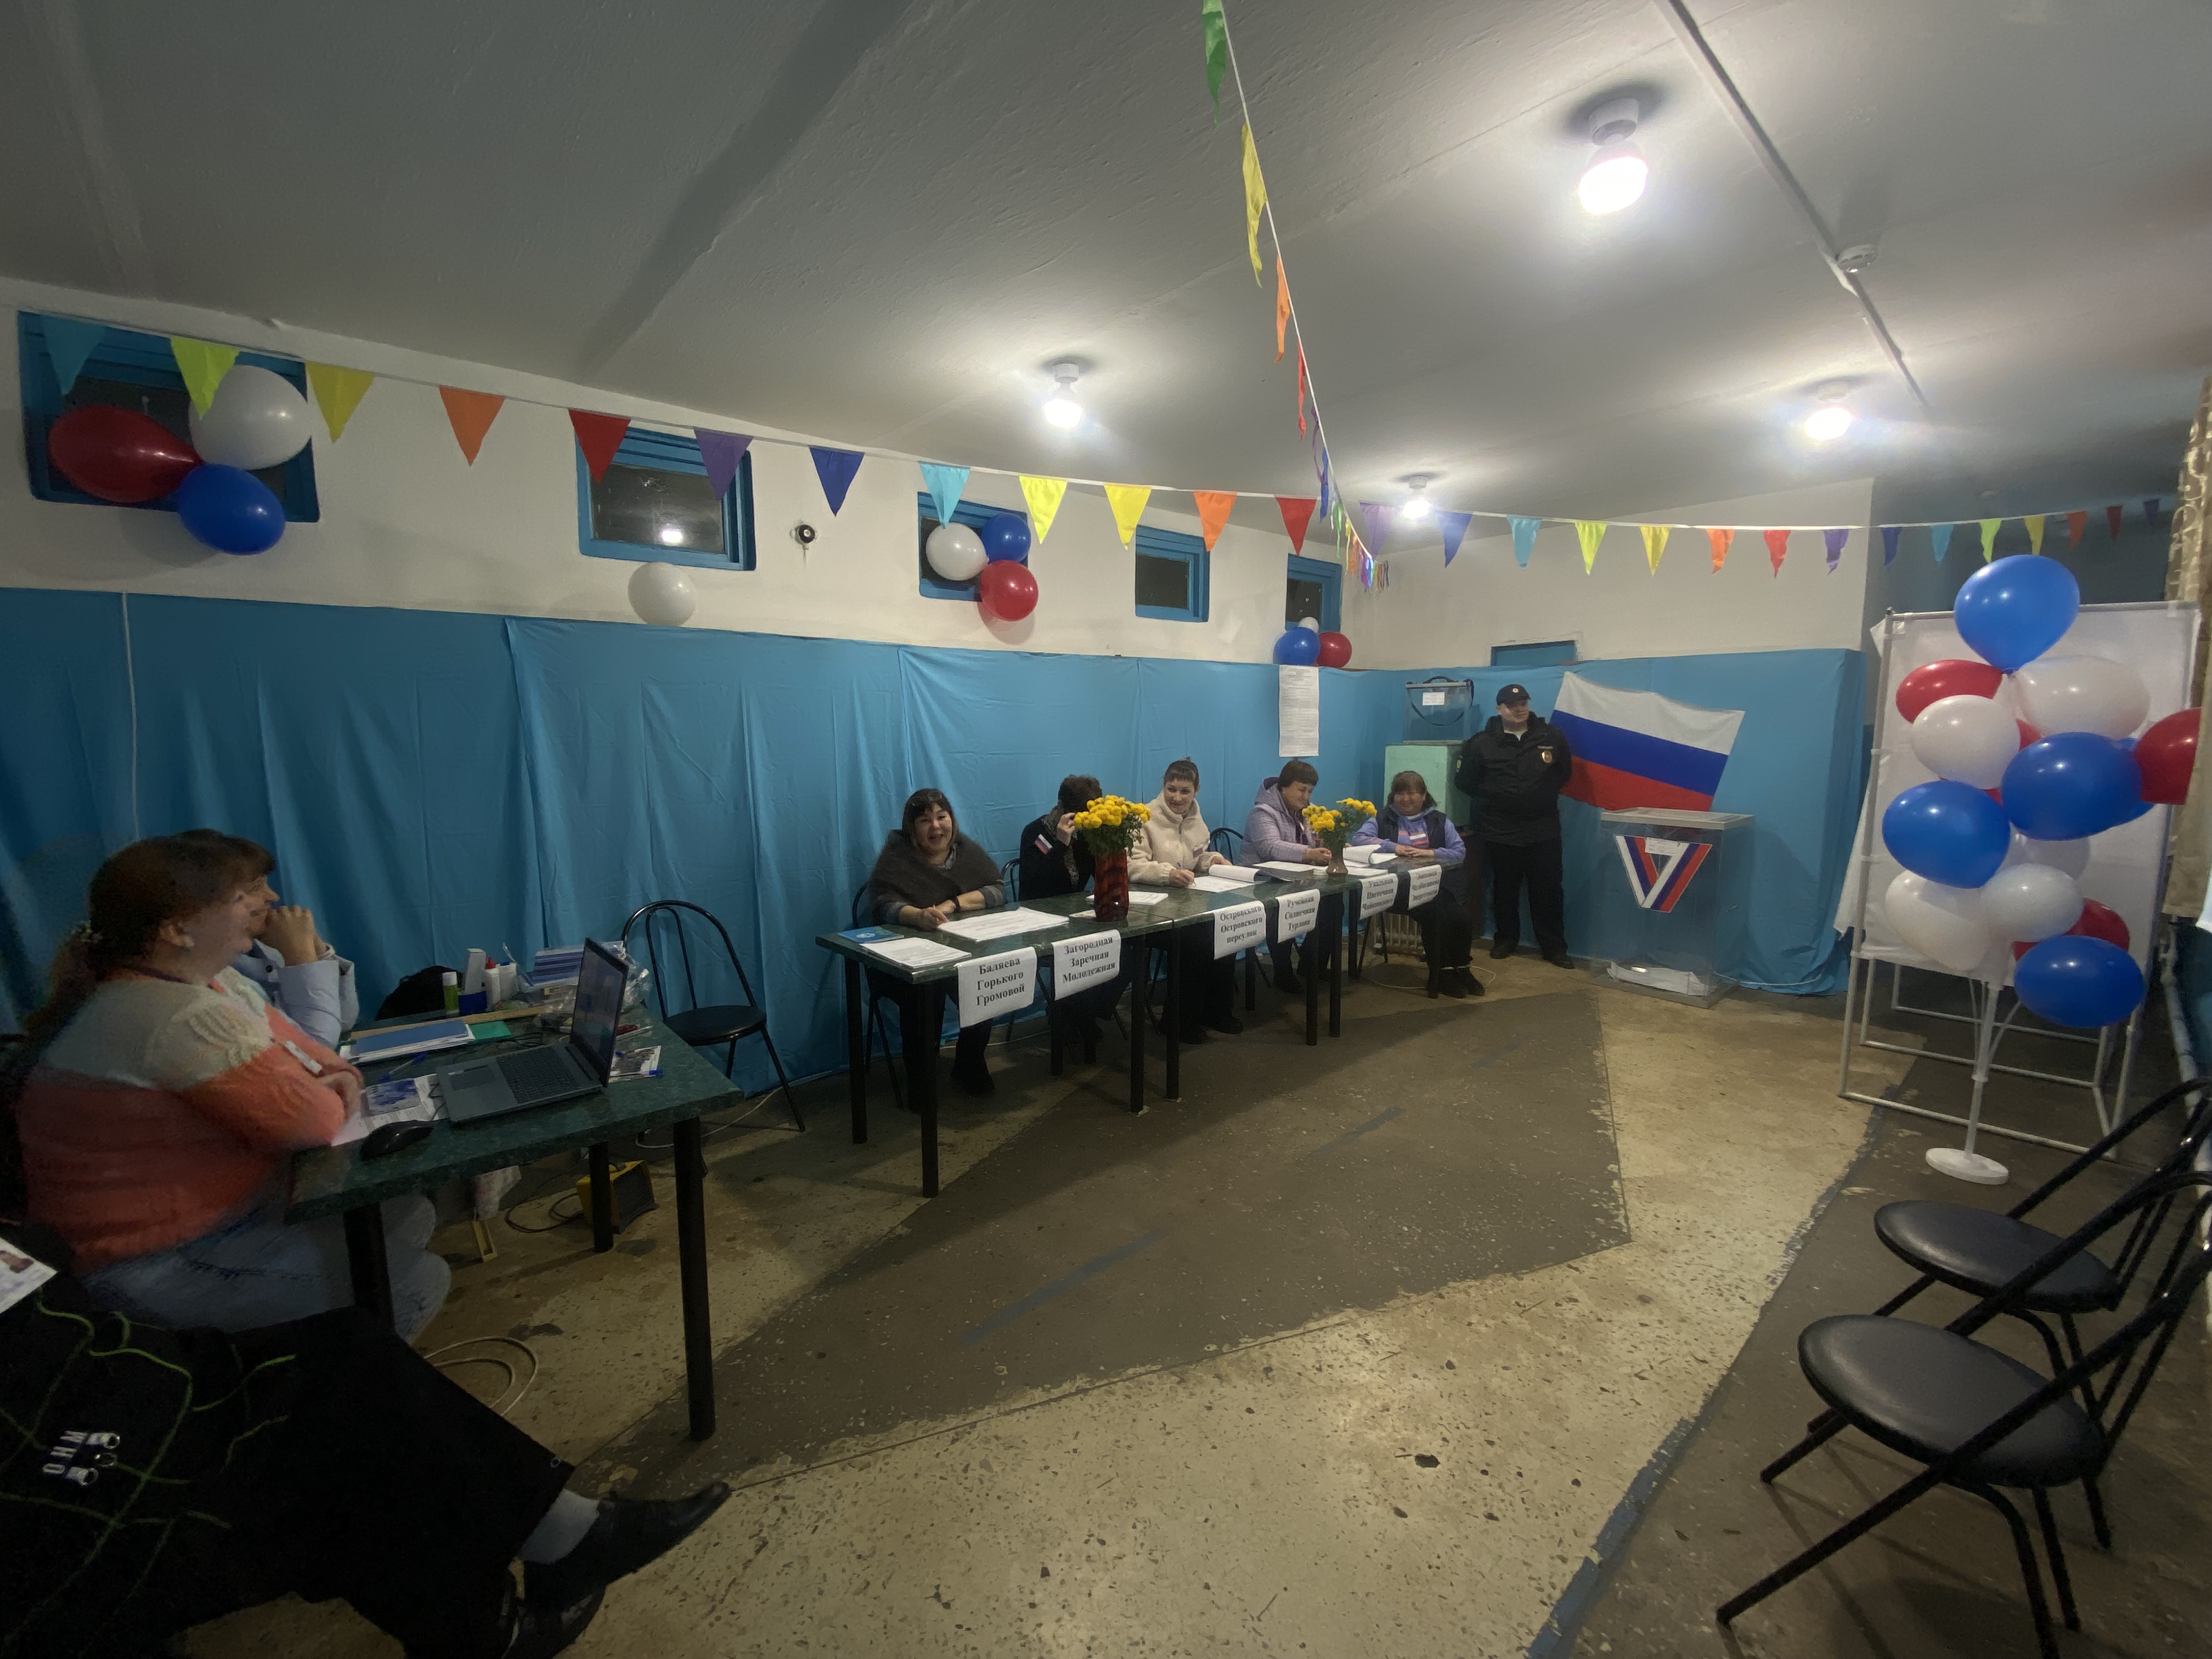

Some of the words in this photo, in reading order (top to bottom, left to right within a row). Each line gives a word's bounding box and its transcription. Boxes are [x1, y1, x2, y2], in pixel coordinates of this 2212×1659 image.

[1220, 906, 1261, 921] Островского
[1285, 907, 1315, 919] Солнечная
[1221, 917, 1263, 933] Островского
[1227, 930, 1257, 943] переулок
[1064, 937, 1113, 955] Загородная
[979, 958, 1020, 974] Баляева
[1070, 952, 1109, 967] Заречная
[1063, 962, 1115, 983] Молодежная
[977, 972, 1024, 990] Горького
[977, 983, 1025, 1006] Громовой
